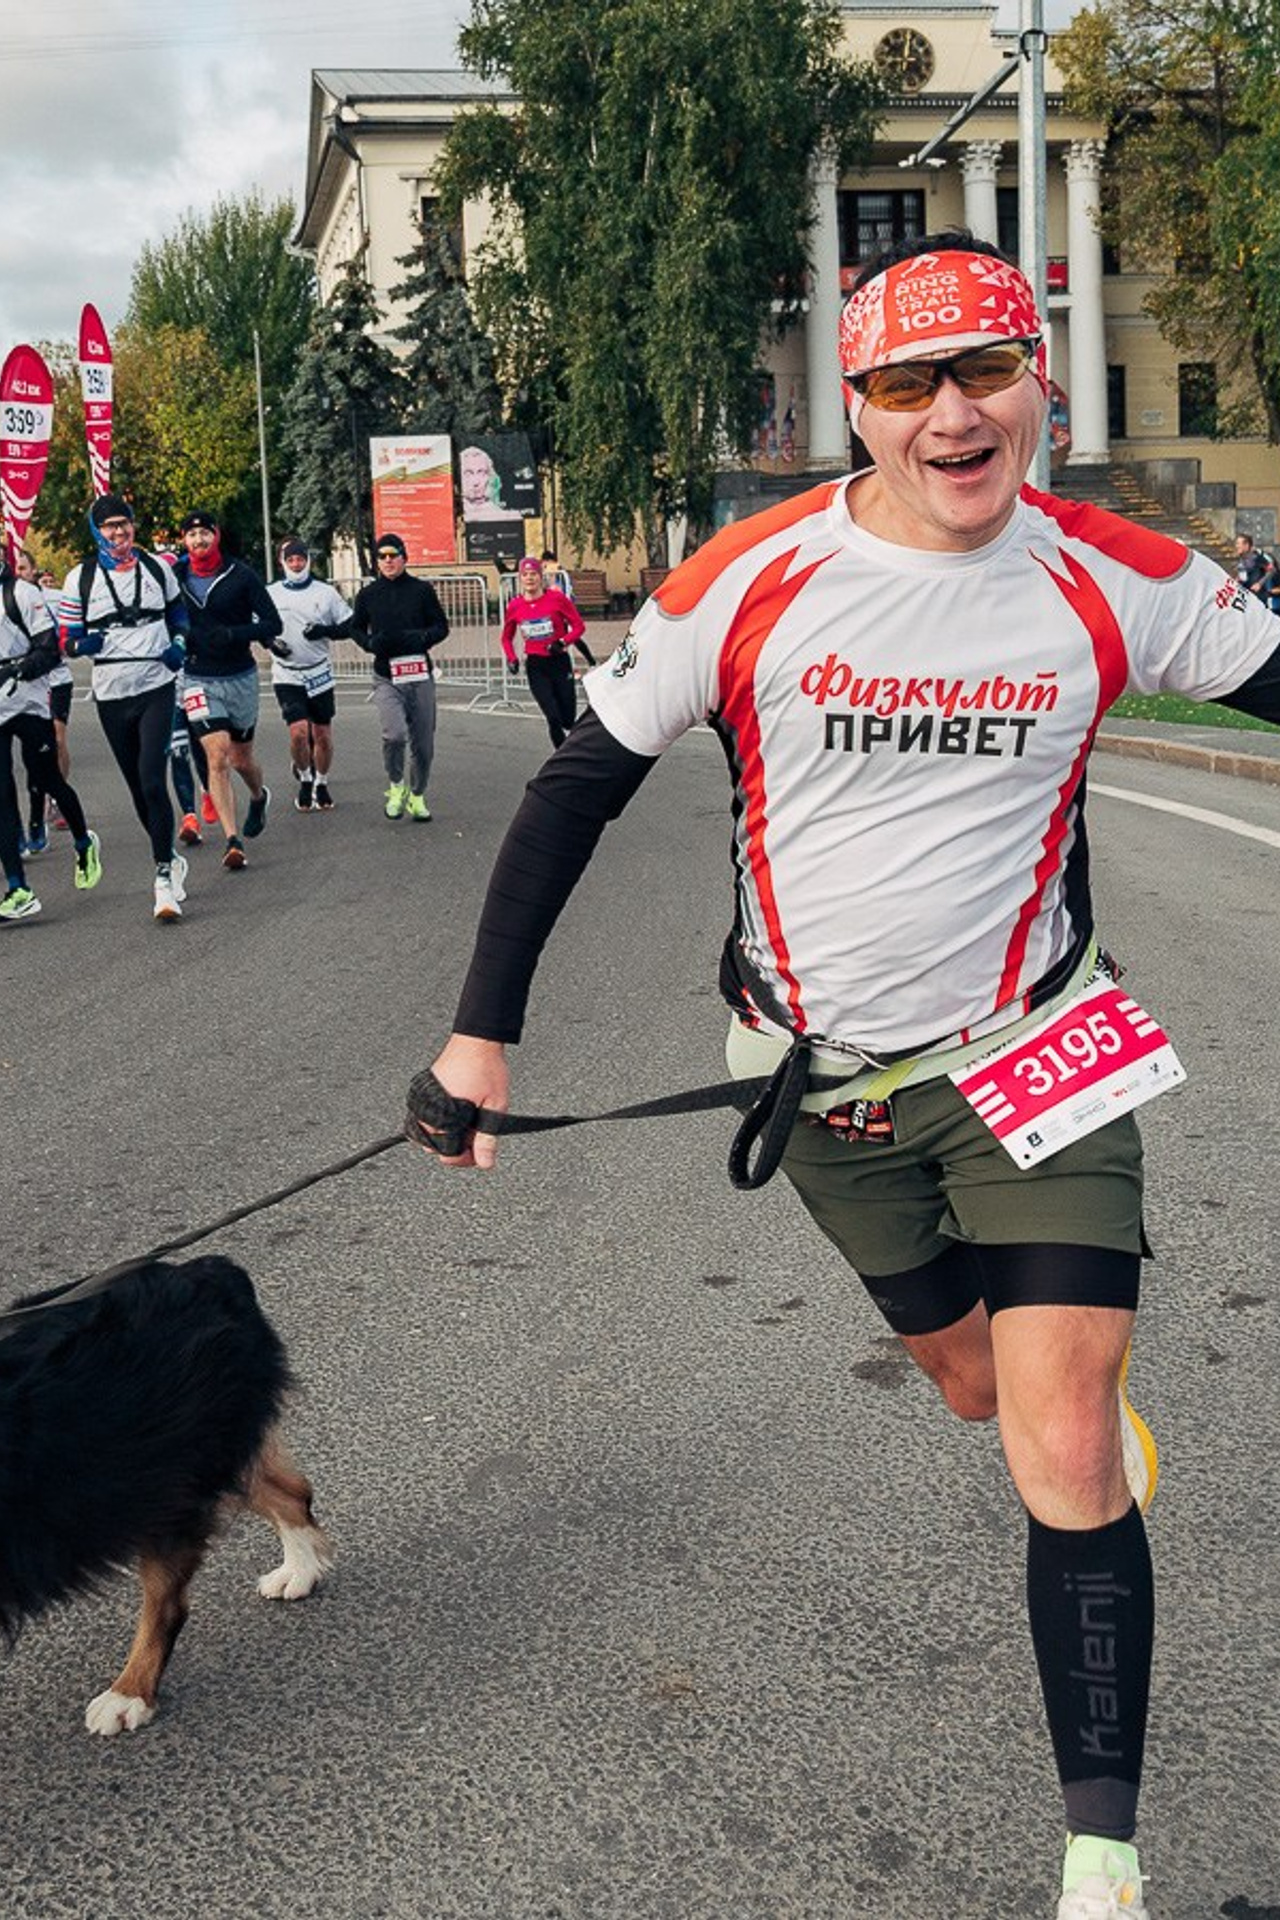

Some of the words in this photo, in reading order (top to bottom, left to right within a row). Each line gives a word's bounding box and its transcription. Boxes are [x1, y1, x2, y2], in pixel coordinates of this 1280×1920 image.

[895, 286, 960, 306] ULTRA
[896, 294, 962, 314] TRAIL
[898, 305, 962, 333] 100
[824, 713, 1037, 757] ПРИВЕТ
[1013, 1011, 1123, 1096] 3195
